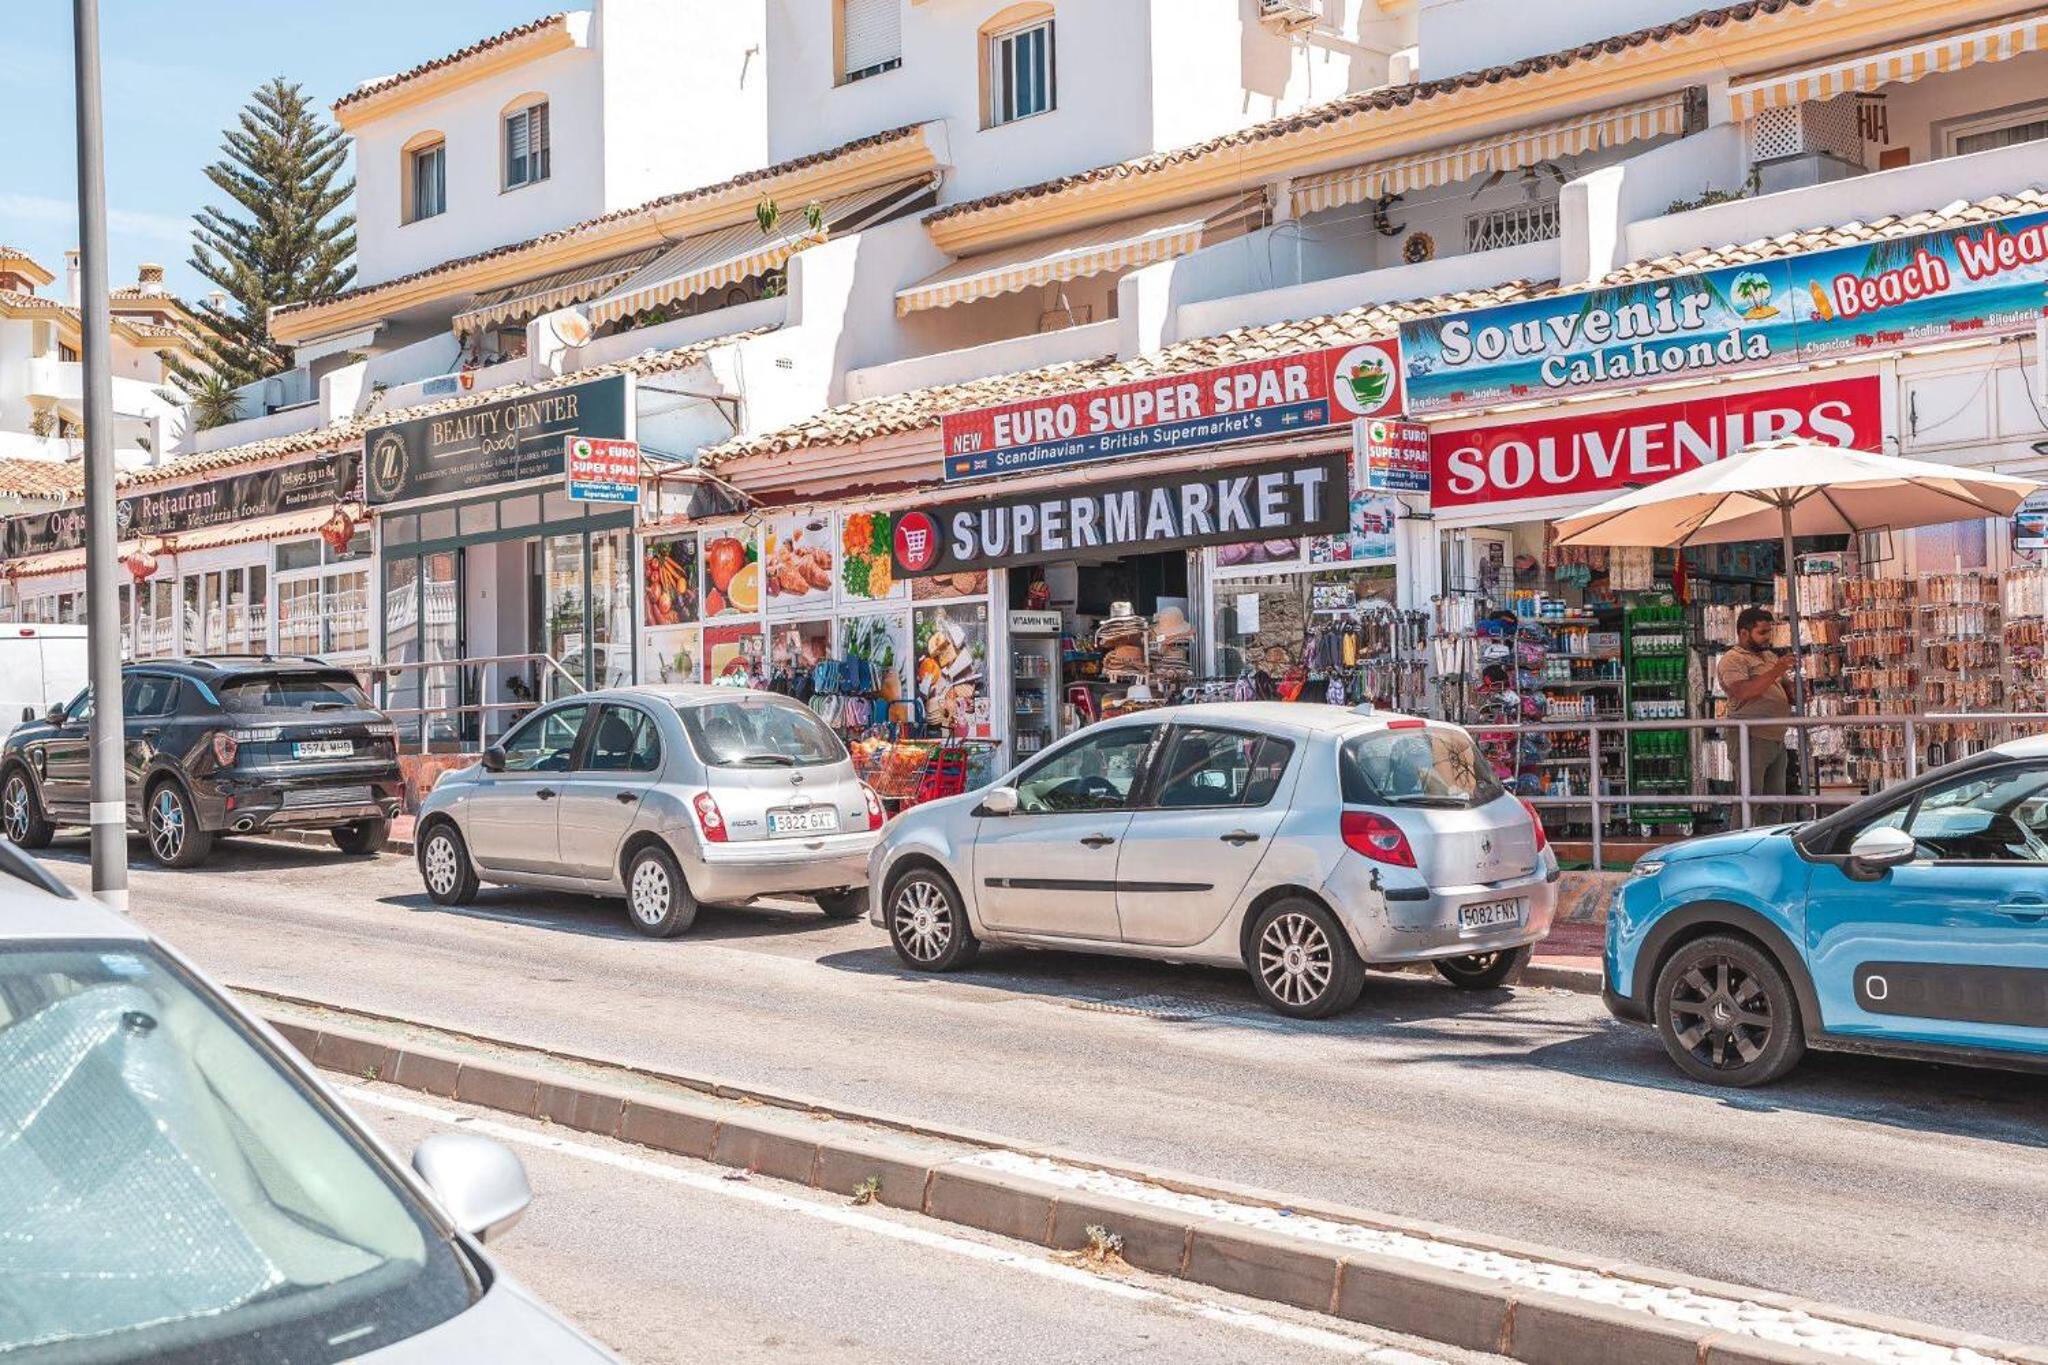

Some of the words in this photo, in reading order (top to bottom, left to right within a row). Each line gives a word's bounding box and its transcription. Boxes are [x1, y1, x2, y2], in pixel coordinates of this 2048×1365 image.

[1835, 250, 1948, 317] Beach
[1441, 286, 1711, 366] Souvenir
[1541, 327, 1772, 388] Calahonda
[432, 408, 501, 446] BEAUTY
[505, 394, 579, 431] CENTER
[953, 431, 982, 453] NEW
[993, 403, 1077, 447] EURO
[1088, 383, 1200, 432] SUPER
[1213, 365, 1309, 413] SPAR
[608, 446, 636, 458] EURO
[996, 442, 1085, 466] Scandinavian
[1100, 431, 1149, 451] British
[1153, 413, 1263, 445] Supermarket's
[1369, 446, 1400, 459] SUPER
[1403, 448, 1428, 462] SPAR
[1402, 429, 1428, 442] EURO
[1447, 400, 1856, 494] SOUVENIRS
[572, 461, 607, 474] SUPER
[609, 464, 636, 476] SPAR
[142, 487, 217, 518] Restaurant
[240, 500, 266, 517] food
[952, 467, 1328, 560] SUPERMARKET
[1464, 906, 1493, 927] 5082
[1495, 902, 1516, 921] FNX
